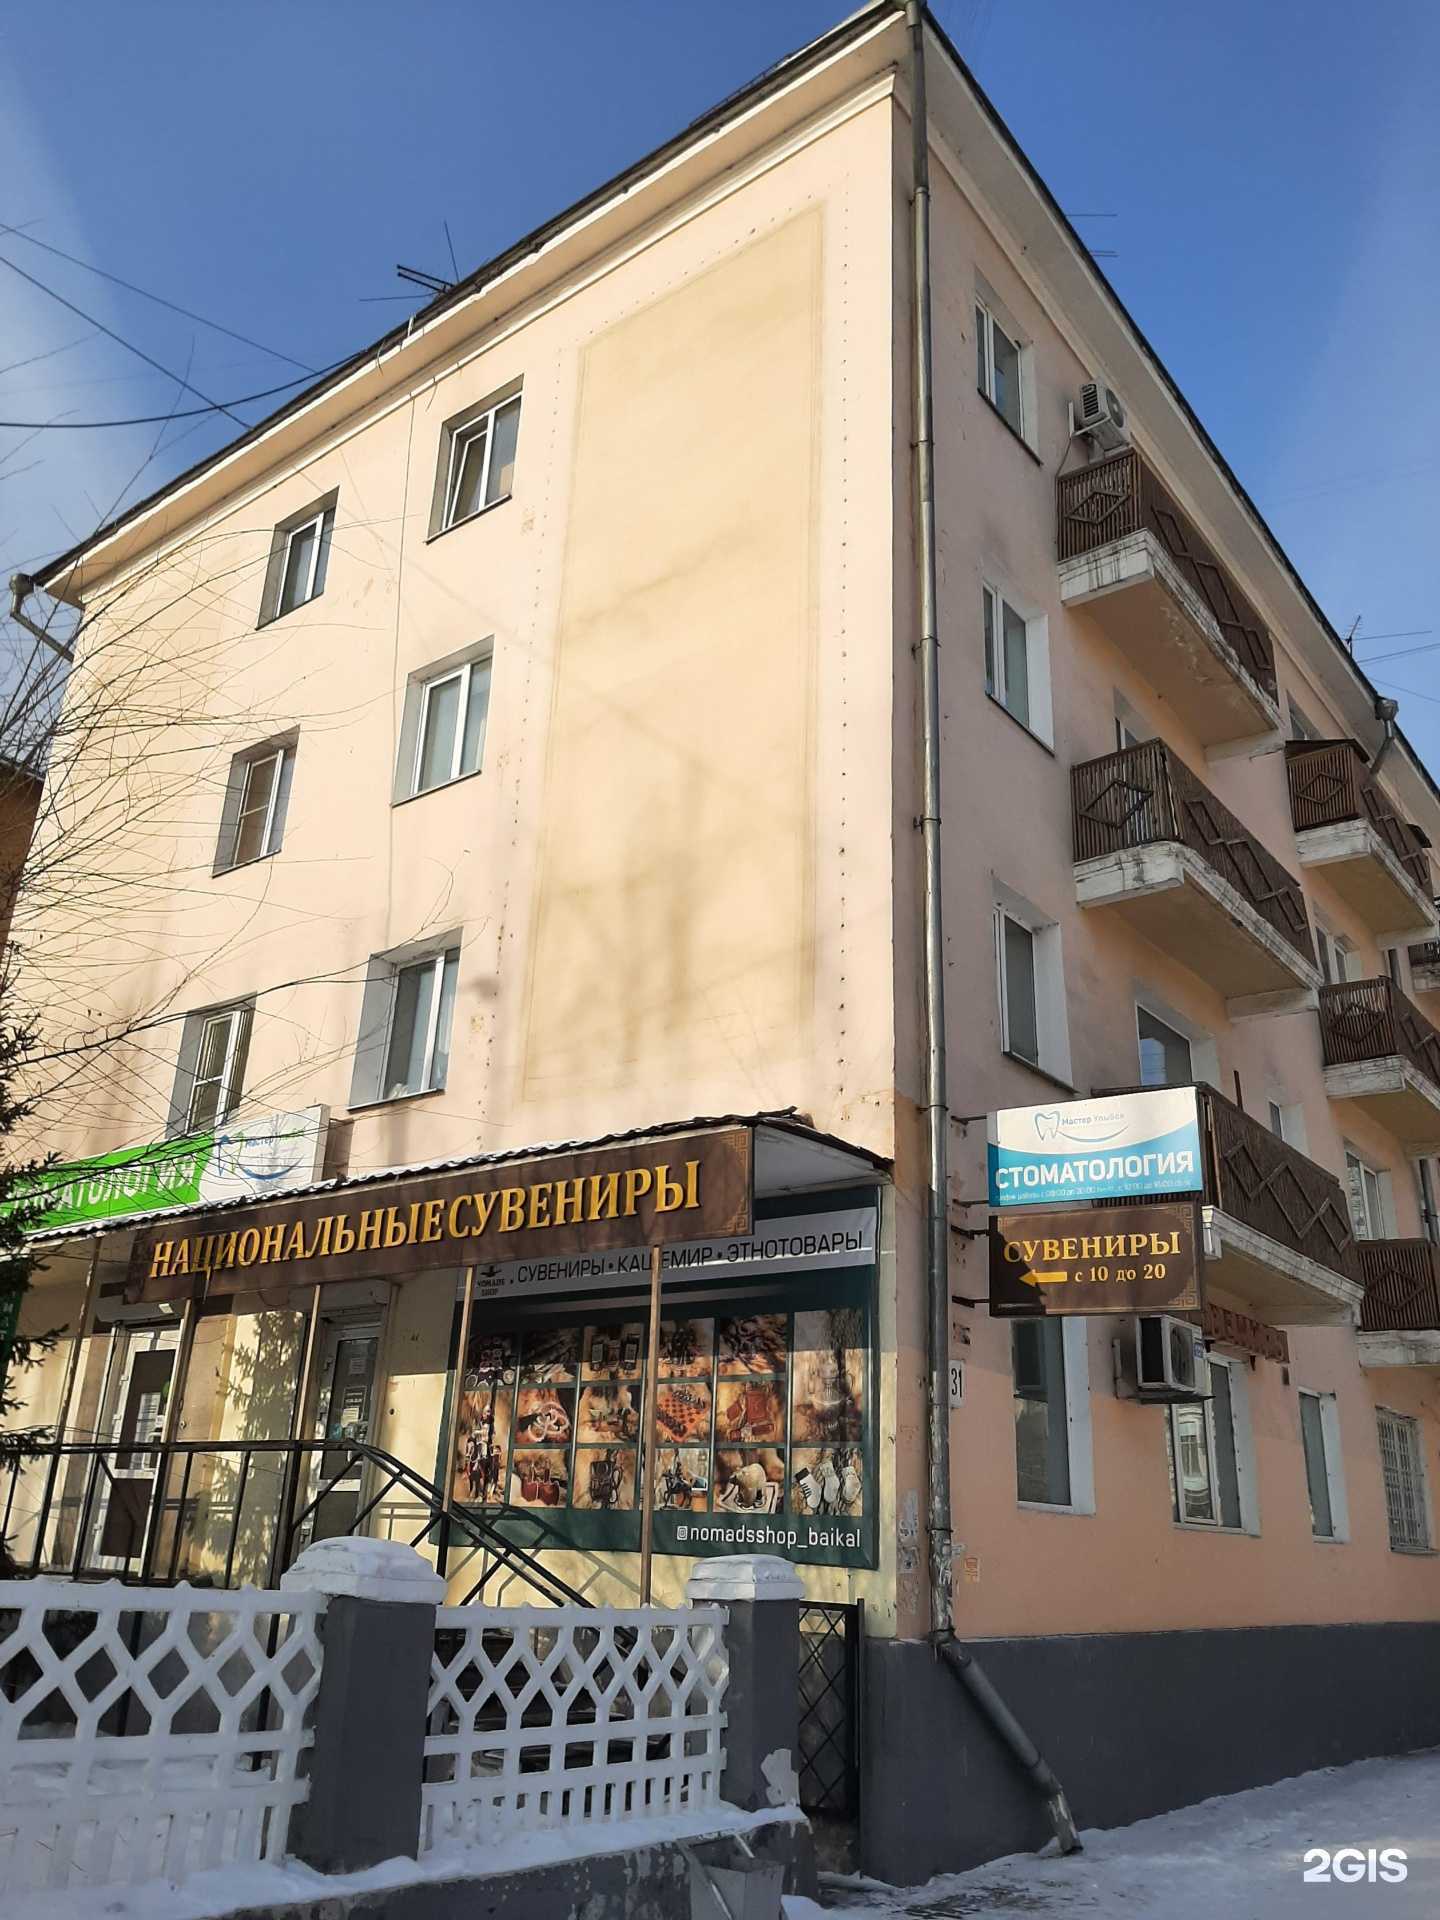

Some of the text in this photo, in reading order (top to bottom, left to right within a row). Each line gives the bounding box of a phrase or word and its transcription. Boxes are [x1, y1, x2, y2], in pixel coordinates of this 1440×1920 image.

[995, 1150, 1194, 1190] СТОМАТОЛОГИЯ
[517, 1257, 605, 1284] СУВЕНИРЫ
[727, 1230, 863, 1263] ЭТНОТОВАРЫ
[1003, 1231, 1181, 1263] СУВЕНИРЫ
[1089, 1266, 1109, 1282] 10
[1115, 1269, 1137, 1282] до
[1143, 1263, 1166, 1280] 20
[951, 1367, 962, 1398] 31
